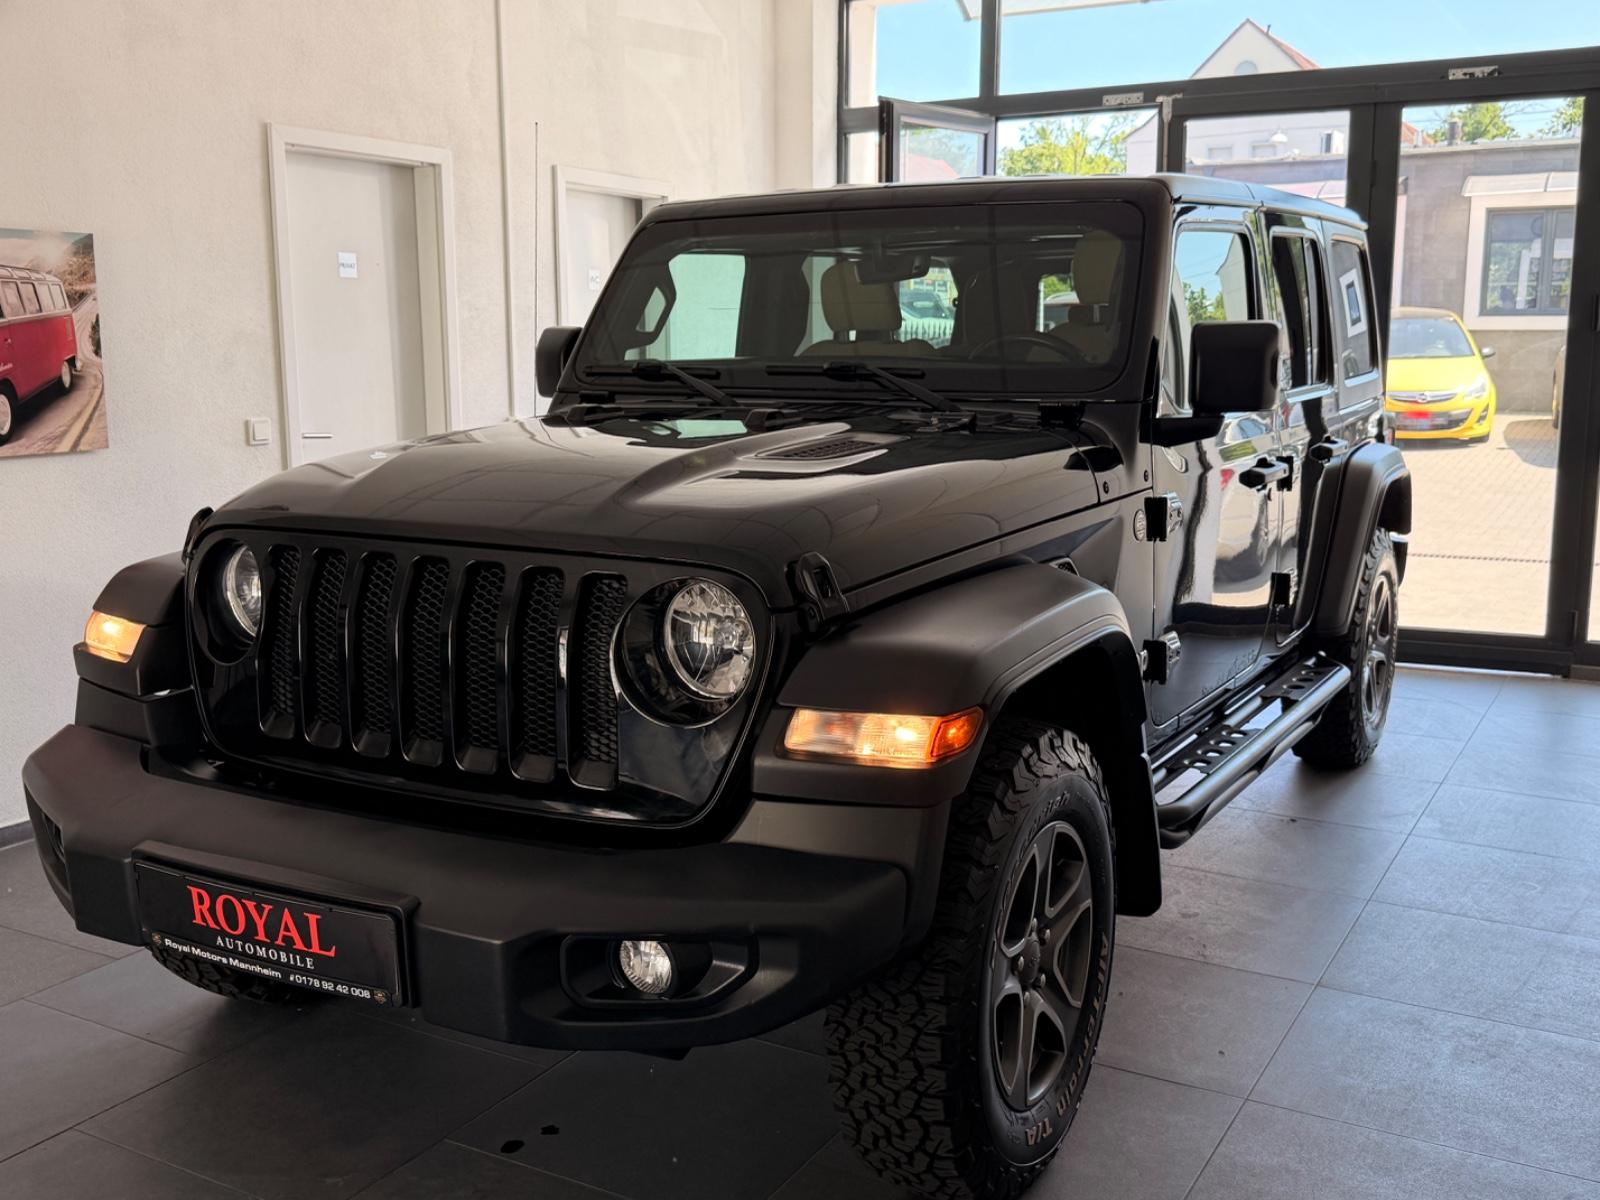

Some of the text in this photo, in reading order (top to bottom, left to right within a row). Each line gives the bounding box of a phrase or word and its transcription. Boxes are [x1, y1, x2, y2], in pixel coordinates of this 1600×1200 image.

[187, 885, 336, 957] ROYAL
[164, 938, 190, 953] Royal
[191, 946, 228, 964] Motors
[229, 957, 282, 978] Mannheim
[321, 980, 335, 991] 92
[336, 984, 349, 995] 42
[351, 987, 371, 999] 008
[216, 936, 315, 969] AUTOMOBILE
